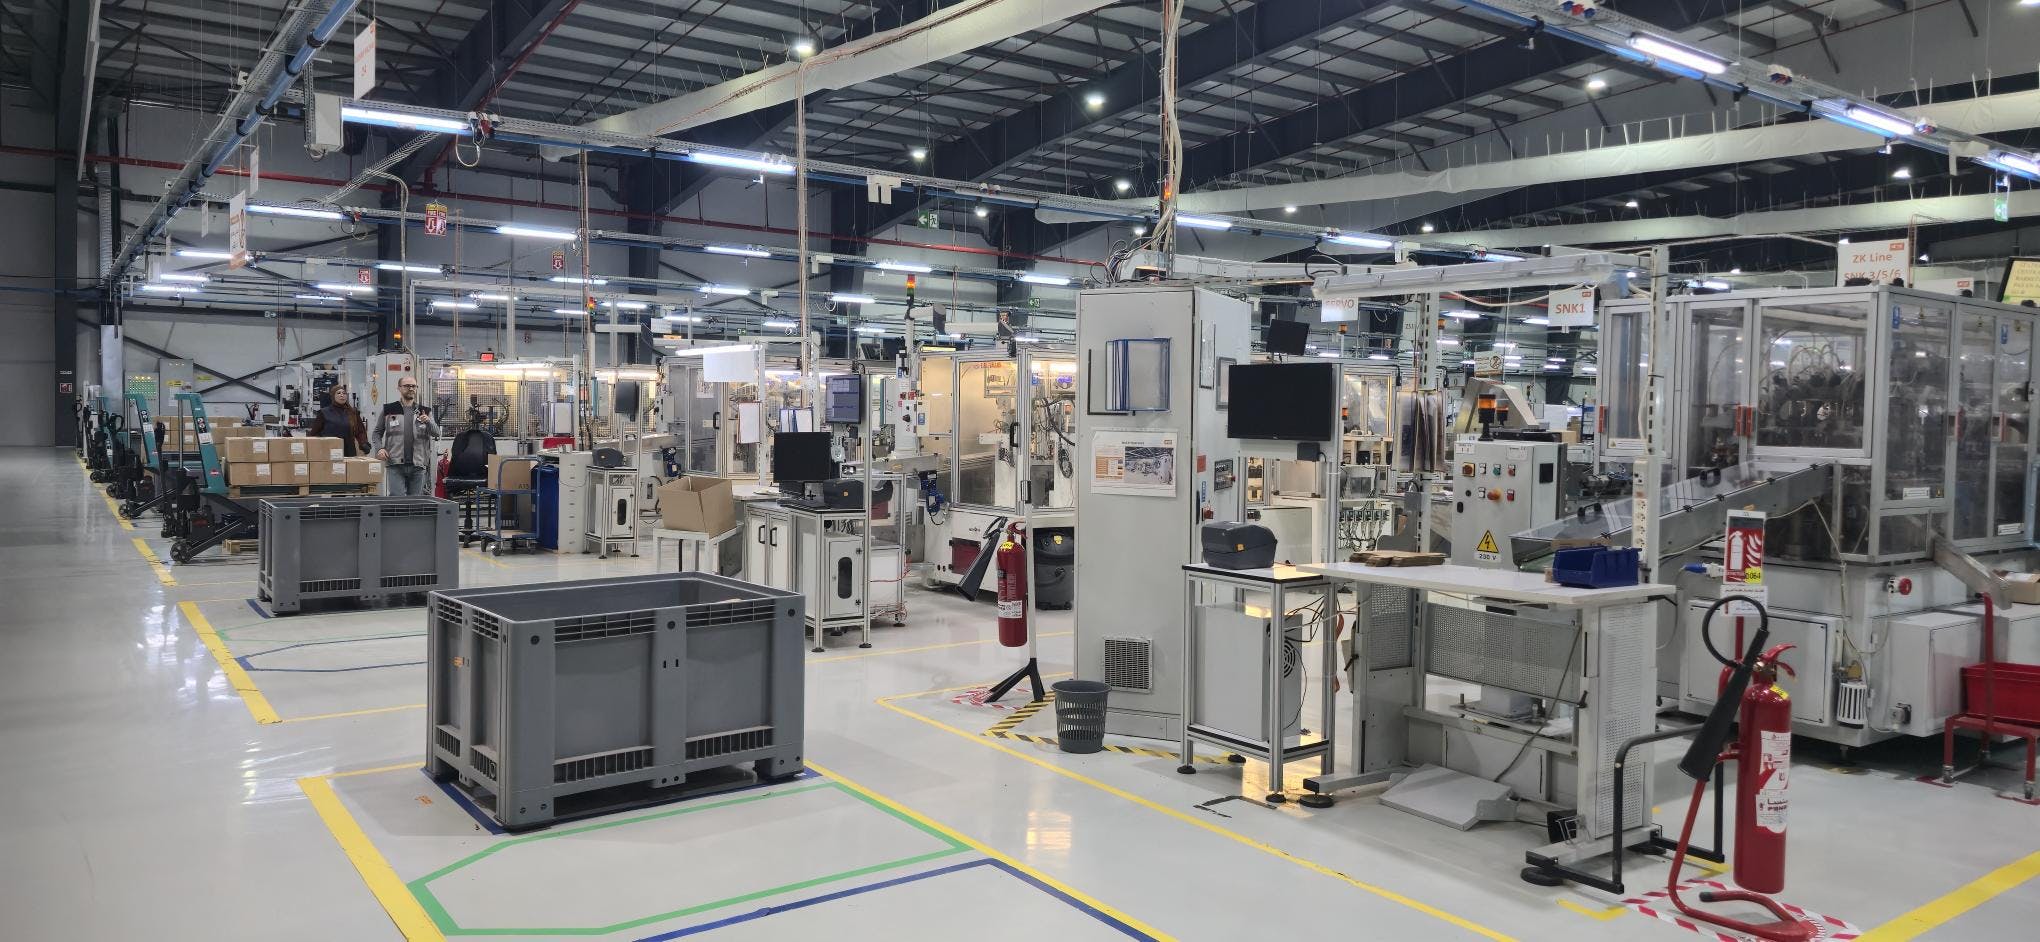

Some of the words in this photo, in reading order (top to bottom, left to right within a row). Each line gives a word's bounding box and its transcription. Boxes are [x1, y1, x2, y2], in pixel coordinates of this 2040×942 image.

[1870, 253, 1893, 263] Line
[1870, 269, 1900, 280] 3/5/6
[1555, 304, 1586, 314] SNK1
